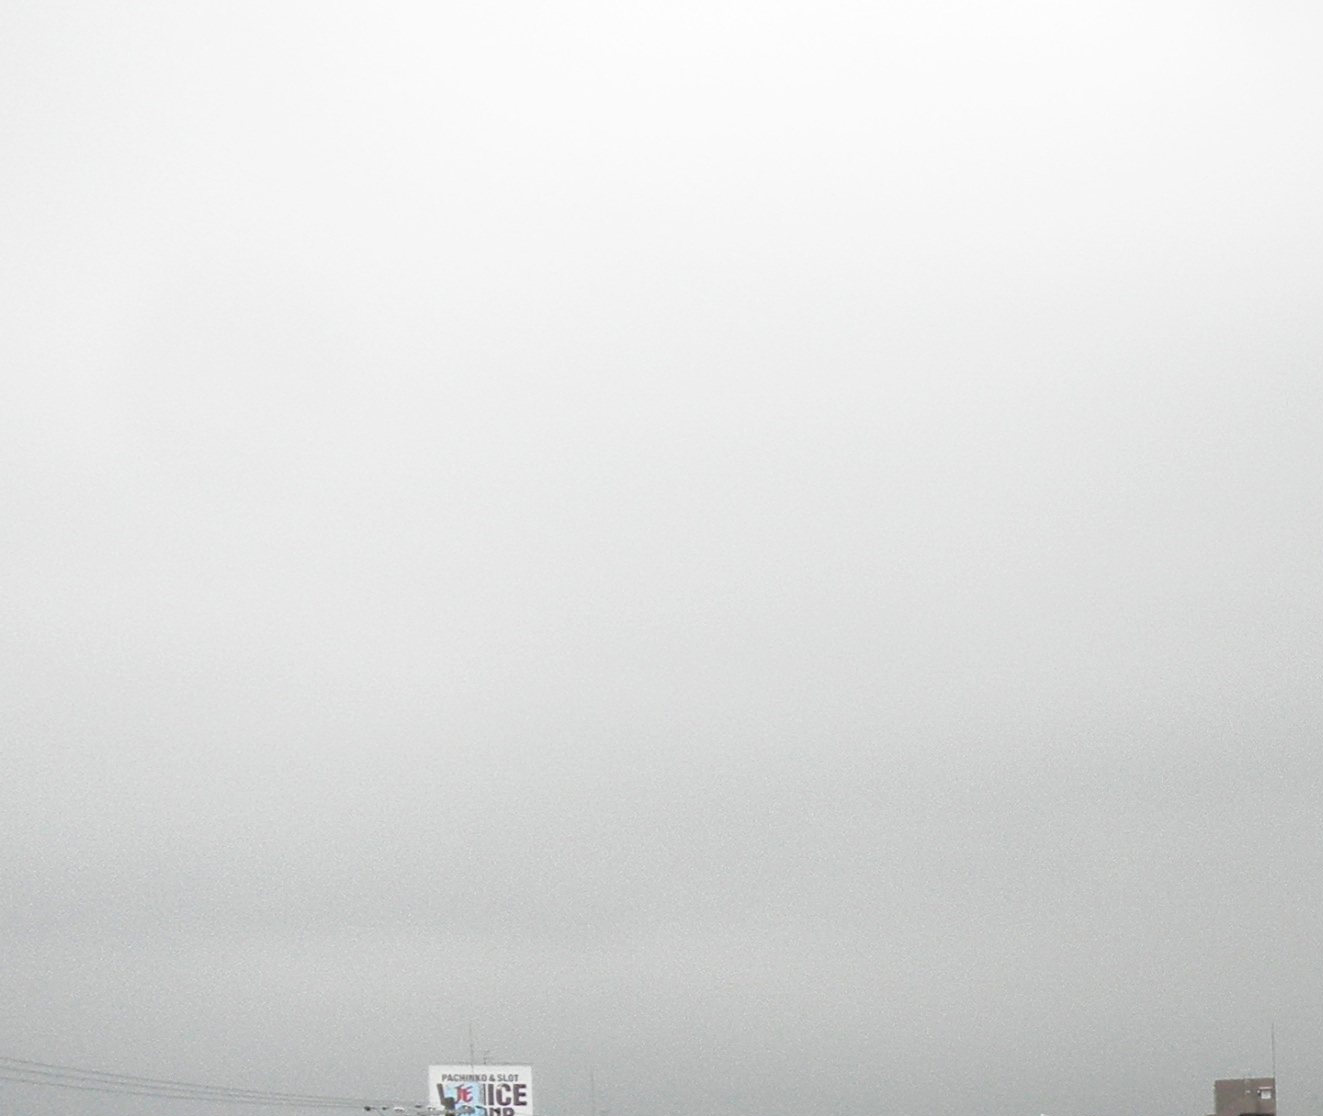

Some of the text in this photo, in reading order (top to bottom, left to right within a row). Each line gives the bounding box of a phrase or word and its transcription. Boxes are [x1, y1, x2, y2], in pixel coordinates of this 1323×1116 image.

[442, 1074, 519, 1082] PACHINKO & SLOT
